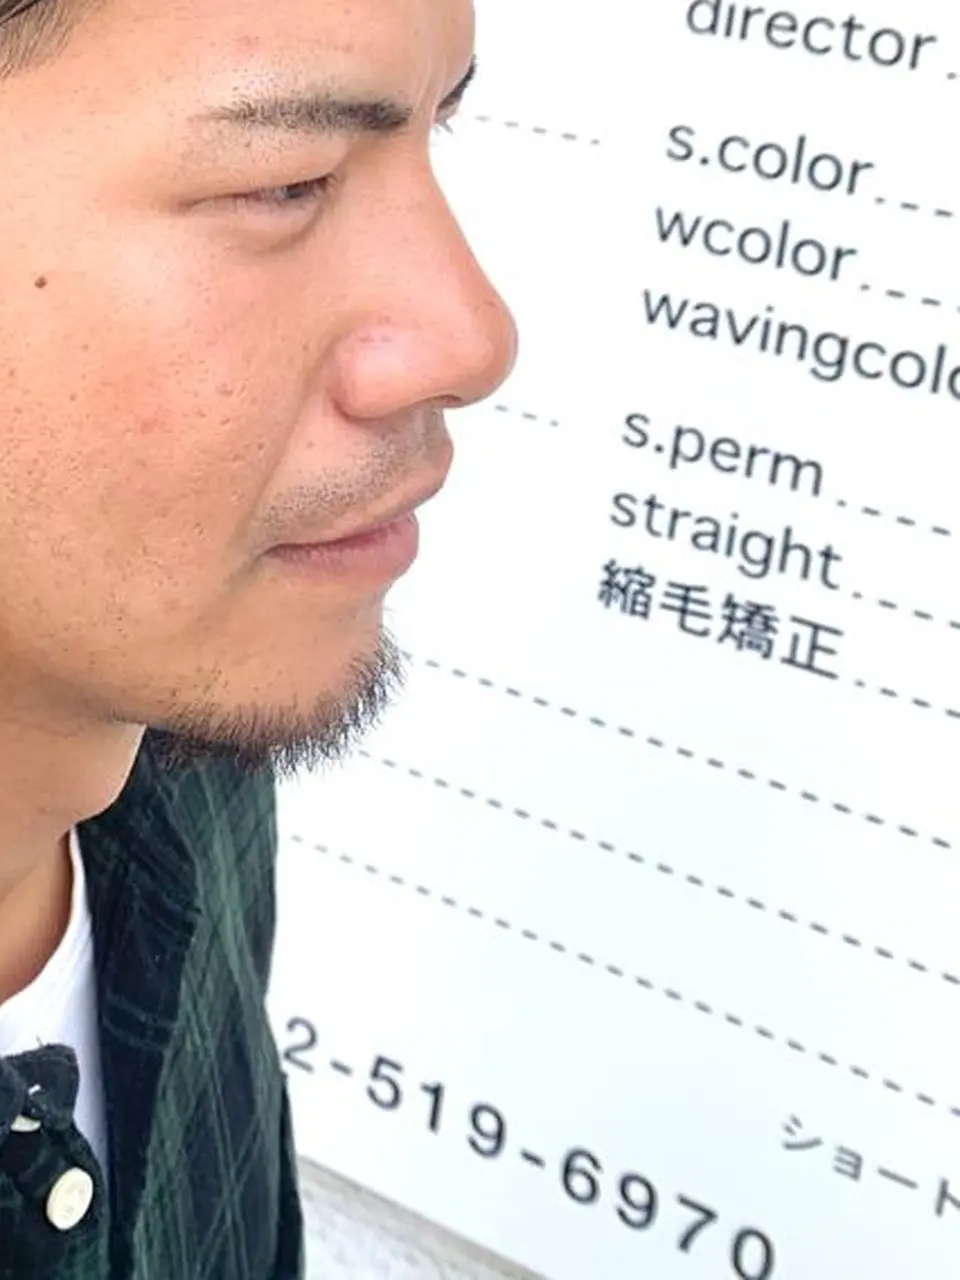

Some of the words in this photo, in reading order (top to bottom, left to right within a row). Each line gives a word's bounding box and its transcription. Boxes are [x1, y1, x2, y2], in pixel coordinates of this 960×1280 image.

[667, 125, 874, 195] s.color
[655, 207, 858, 281] wcolor
[622, 413, 823, 497] s.perm
[610, 492, 842, 591] straight
[597, 558, 844, 680] 縮毛矯正
[282, 1017, 775, 1280] 2-519-6970
[781, 1113, 960, 1218] ショート
